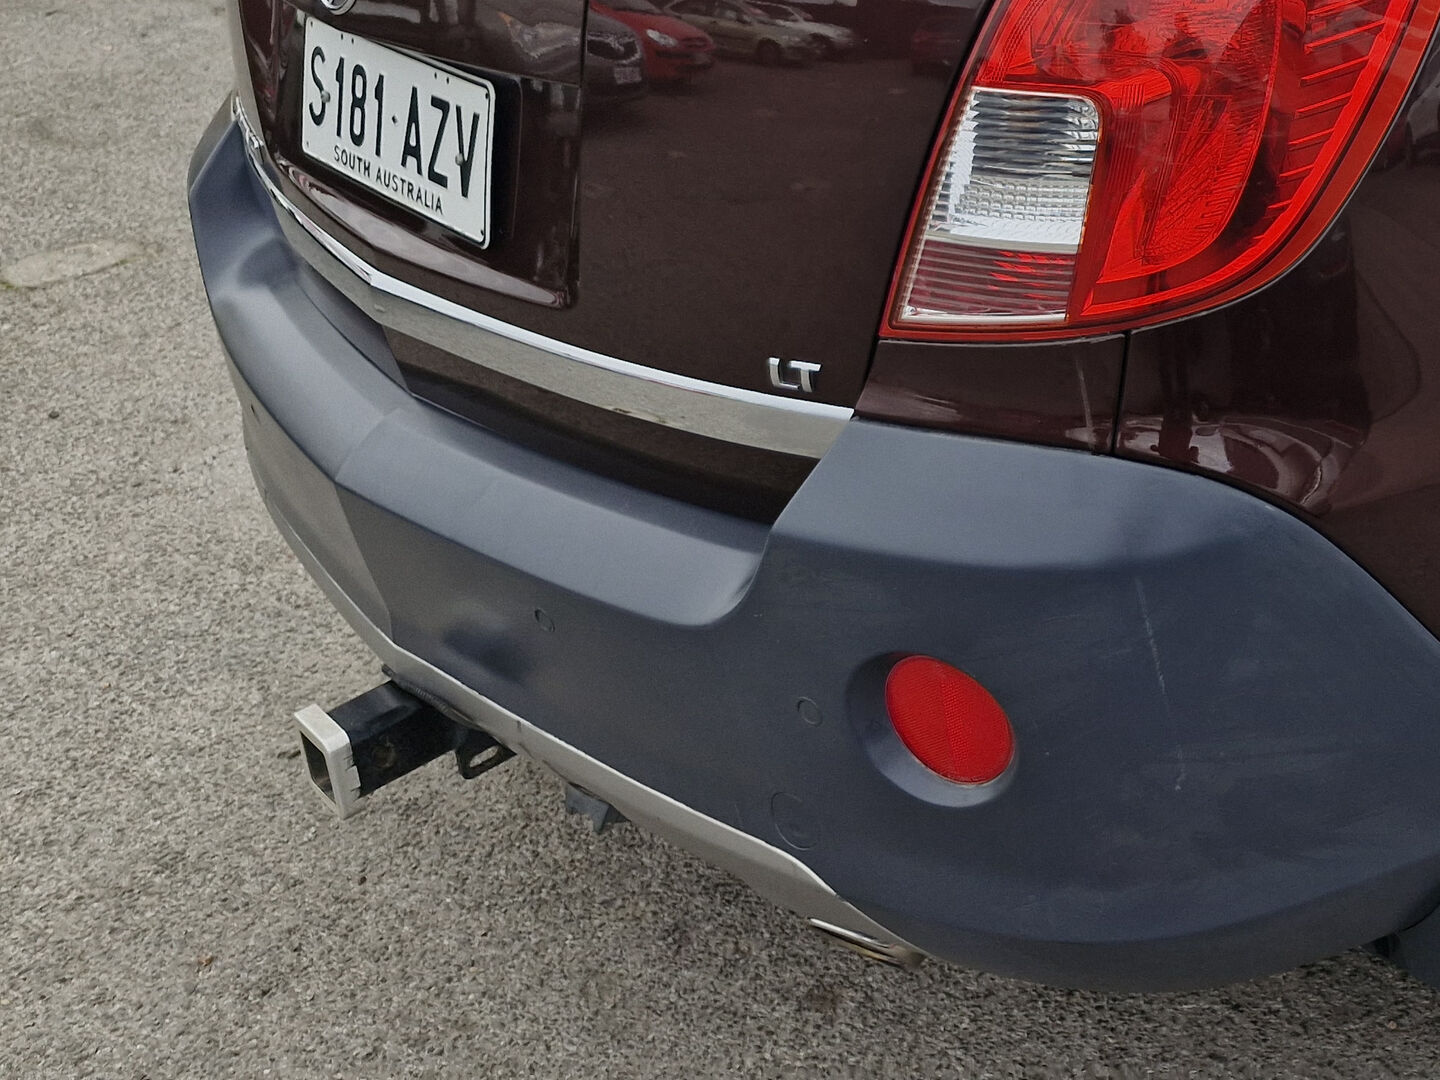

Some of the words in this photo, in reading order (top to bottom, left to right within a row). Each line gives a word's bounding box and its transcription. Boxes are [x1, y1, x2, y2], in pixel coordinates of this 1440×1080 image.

[333, 144, 372, 178] SOUTH
[375, 165, 445, 216] AUSTRALIA
[767, 356, 822, 393] LT
